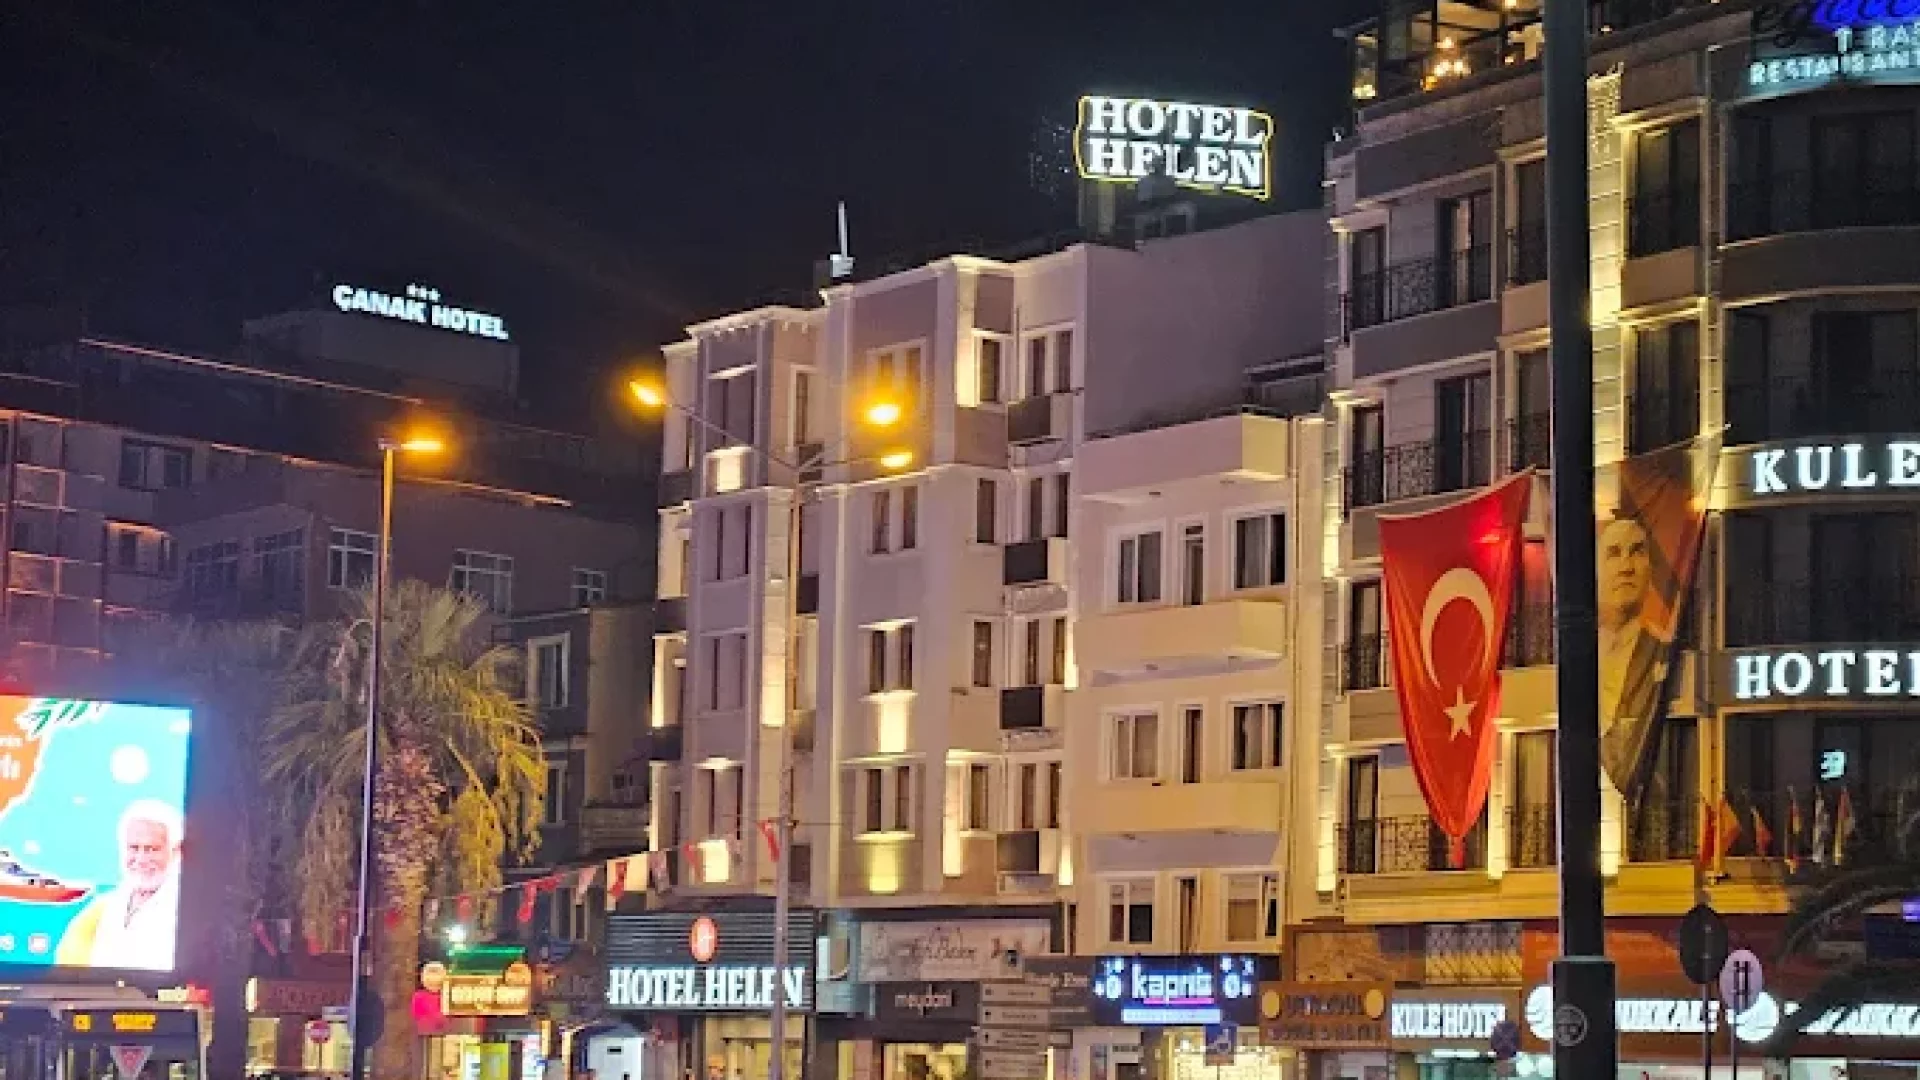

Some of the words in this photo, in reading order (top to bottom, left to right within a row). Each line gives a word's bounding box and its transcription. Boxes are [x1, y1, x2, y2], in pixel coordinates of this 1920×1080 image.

[1087, 96, 1265, 145] HOTEL
[1087, 138, 1263, 188] HELEN
[333, 284, 427, 323] ÇANAK
[431, 304, 509, 341] HOTEL
[1752, 443, 1920, 493] KULE
[608, 967, 699, 1006] HOTEL
[704, 967, 806, 1007] HELEN
[1391, 1002, 1440, 1039] KULE
